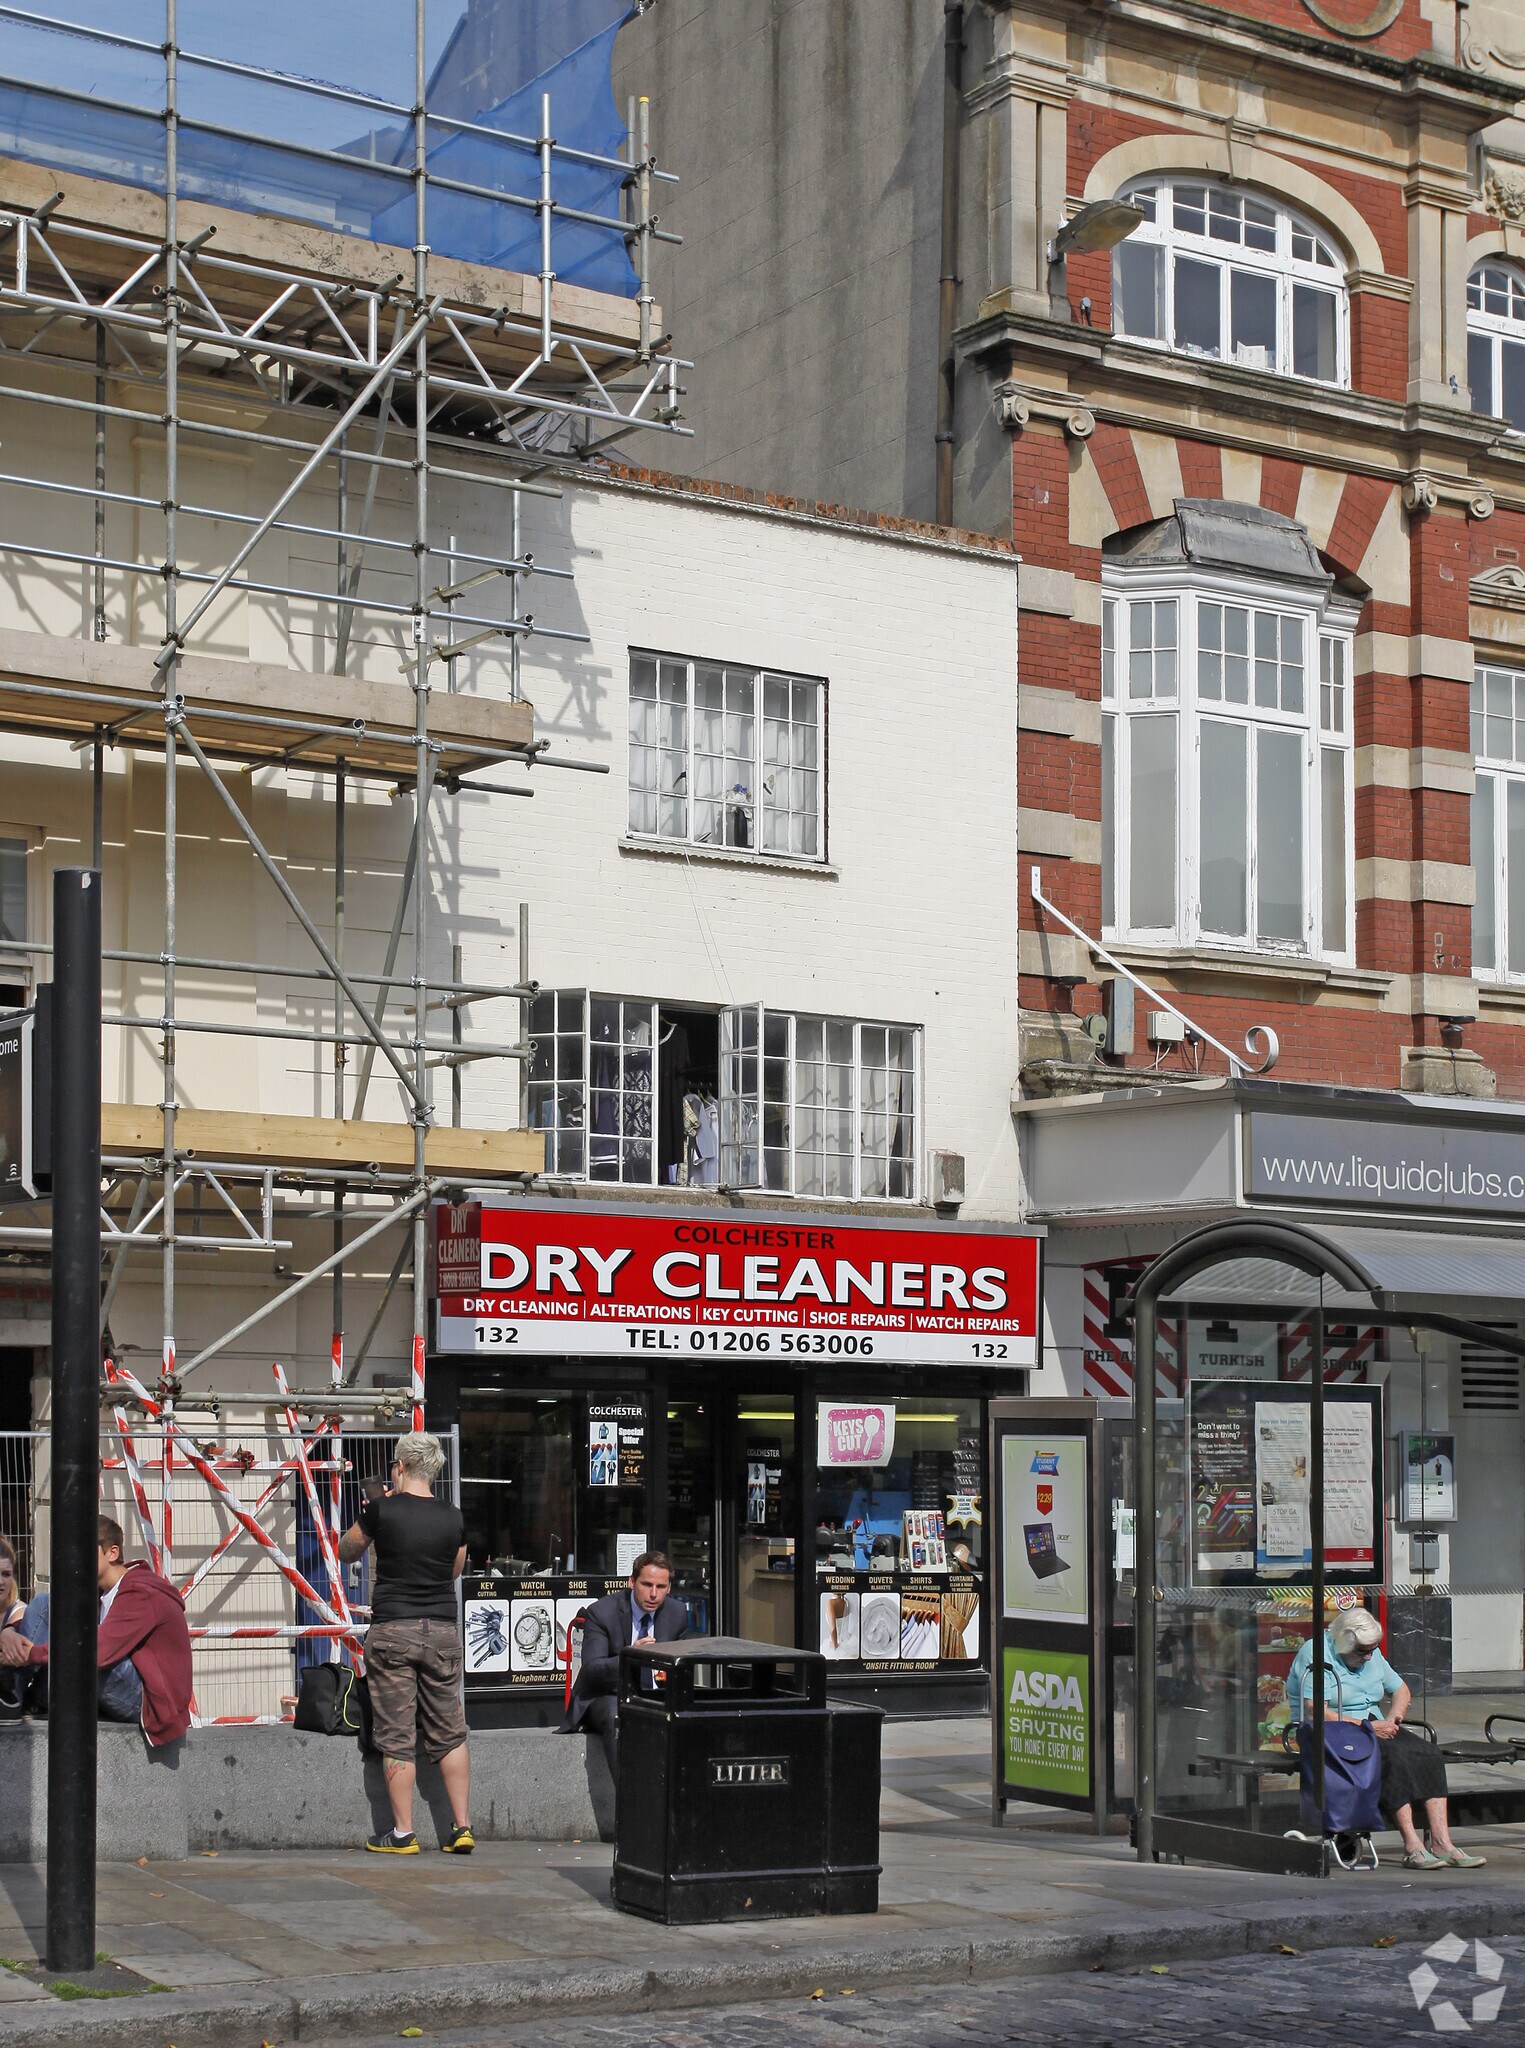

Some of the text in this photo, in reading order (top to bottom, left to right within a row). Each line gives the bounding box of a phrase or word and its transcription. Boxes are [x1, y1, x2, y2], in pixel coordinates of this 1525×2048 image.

[450, 1209, 468, 1234] DRY
[674, 1225, 835, 1249] COLCHESTER
[438, 1238, 480, 1264] CLEANERS
[459, 1271, 480, 1287] SERVICE
[481, 1242, 1008, 1311] DRY CLEANERS
[463, 1298, 1019, 1331] DRY CLEANING ALTERATIONS KEY CUTTING SHOE REPAIRS WATCH REPAIRS
[474, 1326, 519, 1344] 132
[626, 1328, 874, 1356] TEL: 01206 563006
[971, 1343, 1008, 1359] 132
[1085, 1350, 1115, 1362] THE
[1198, 1353, 1265, 1367] TURKISH
[589, 1406, 642, 1416] COLCHESTER
[832, 1418, 864, 1437] KEYS
[1220, 1431, 1240, 1440] thing?
[837, 1434, 862, 1452] CUT
[480, 1581, 495, 1590] KEY
[520, 1581, 545, 1589] WATCH
[568, 1581, 588, 1589] SHOE
[825, 1576, 855, 1584] WEDDING
[868, 1576, 894, 1584] DUVETS
[909, 1576, 933, 1585] SHIRTS
[890, 1662, 914, 1670] FITTING
[511, 1674, 548, 1683] Telephone:
[1009, 1669, 1084, 1713] ASDA
[1009, 1716, 1085, 1742] SAVING
[1009, 1735, 1085, 1762] YOU MONEY EVERY DAY
[716, 1763, 783, 1783] LITTER
